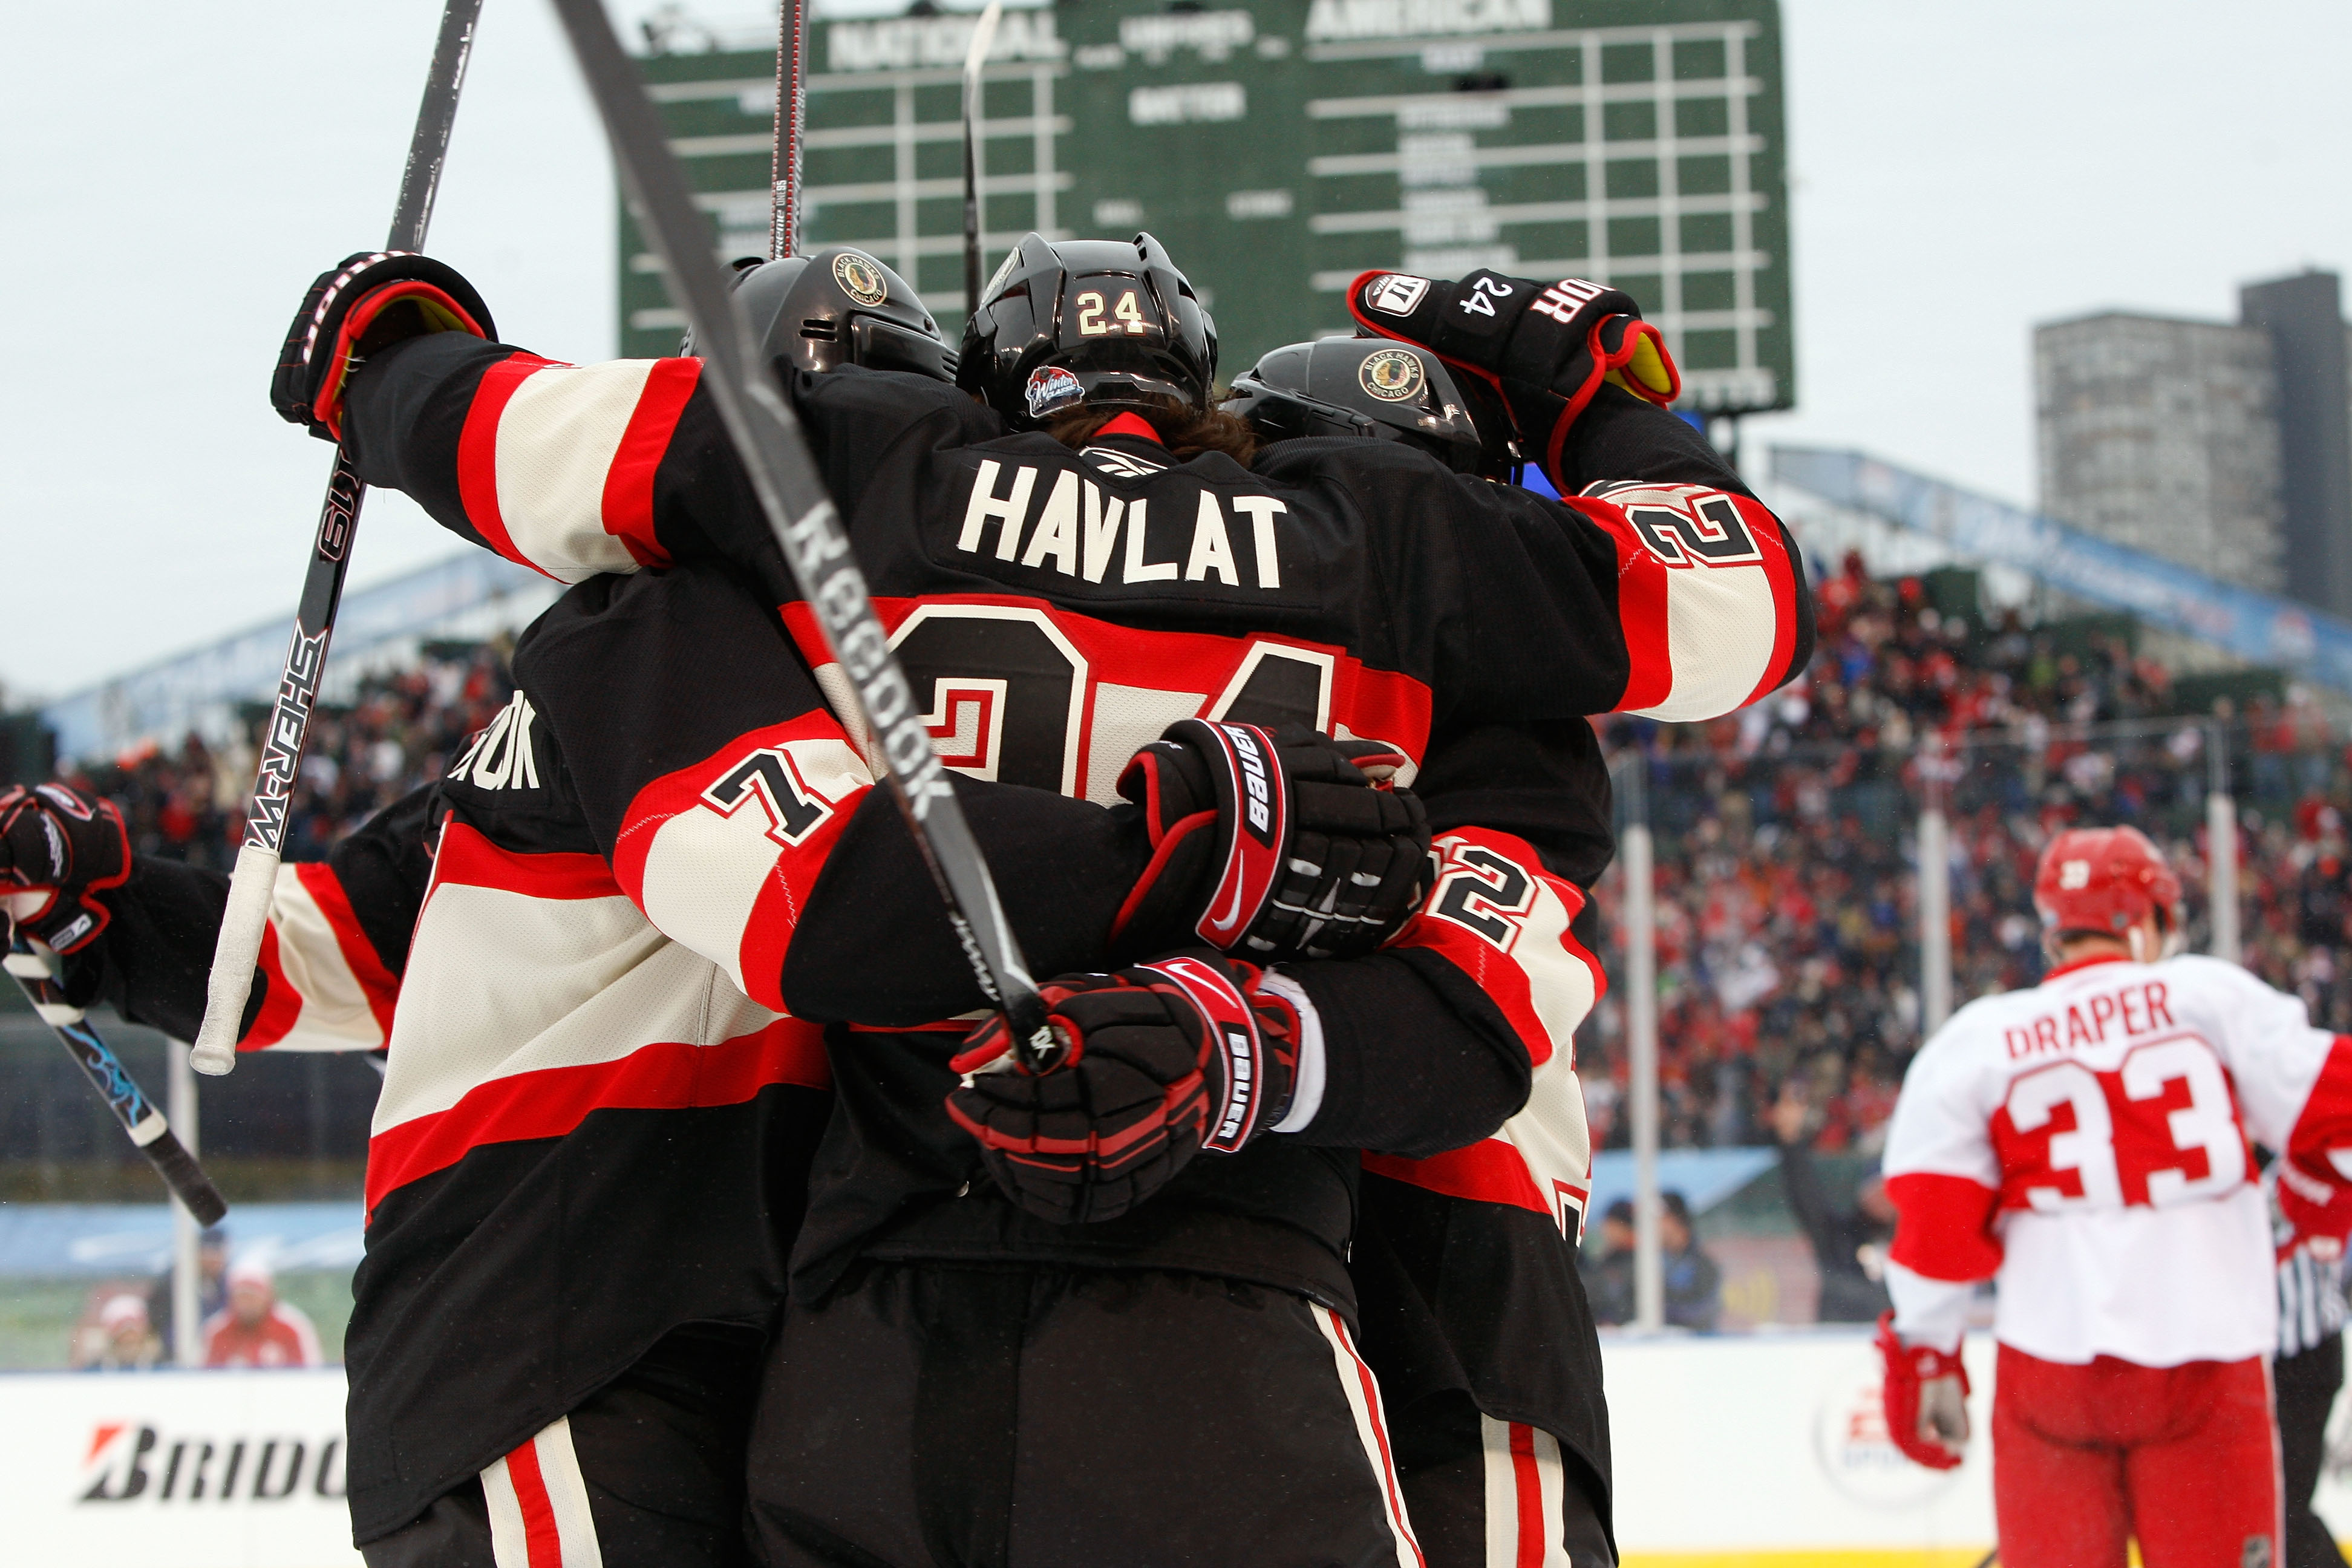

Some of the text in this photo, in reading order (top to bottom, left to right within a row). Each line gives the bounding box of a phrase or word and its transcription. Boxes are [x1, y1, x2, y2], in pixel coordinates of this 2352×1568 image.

[850, 289, 883, 303] CHICAGO
[1076, 290, 1145, 336] 24
[1459, 276, 1514, 318] 24
[1364, 352, 1420, 379] BLACK HAWKS
[1366, 381, 1410, 398] CHICAGO
[957, 459, 1287, 589] HAVLAT
[700, 748, 835, 847] 7
[1220, 724, 1270, 833] BAUER
[2004, 980, 2177, 1060] DRAPER
[1218, 1032, 1251, 1138] BAUER
[2004, 1031, 2247, 1210] 33
